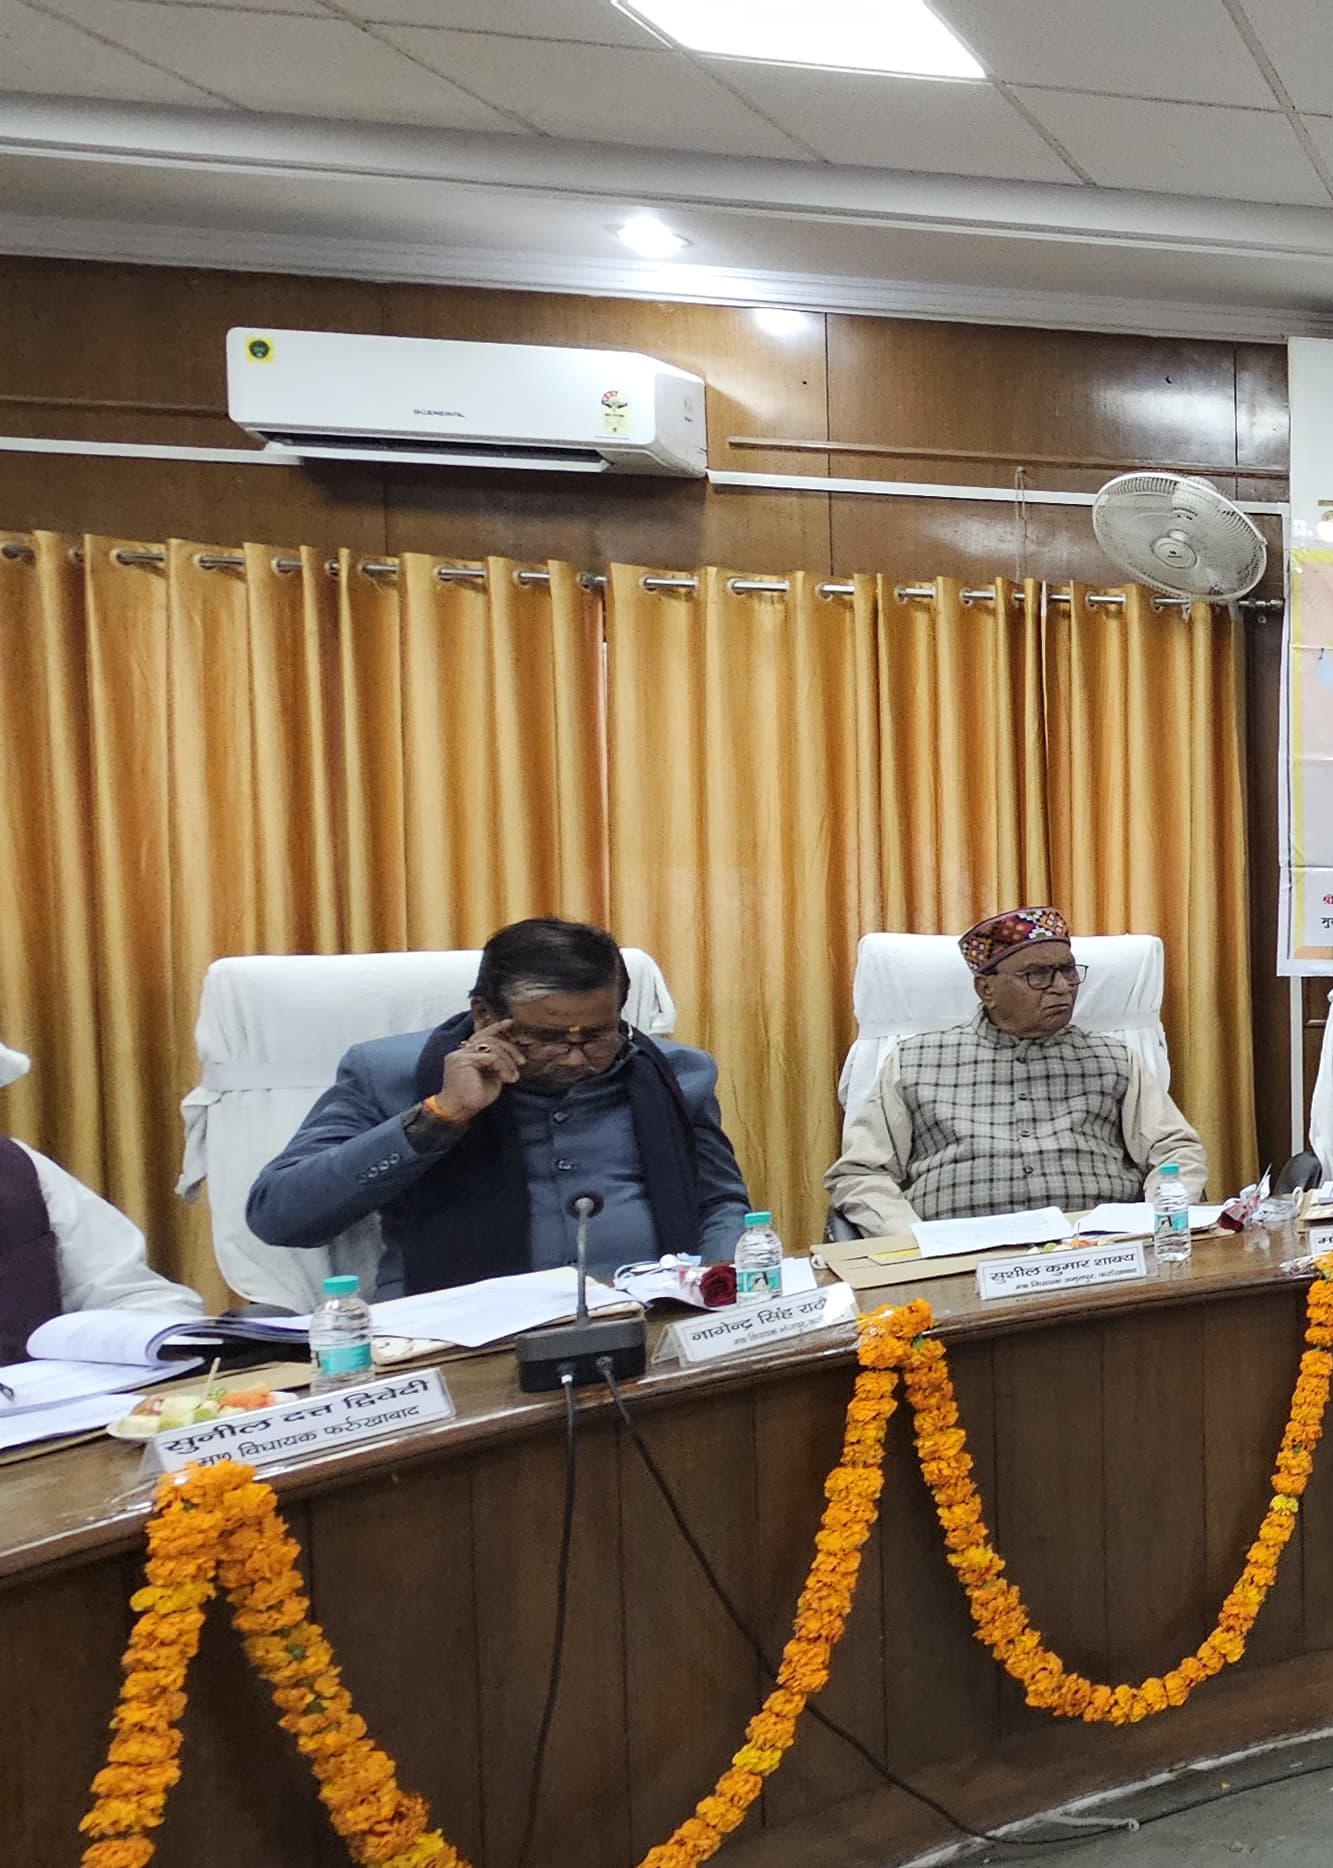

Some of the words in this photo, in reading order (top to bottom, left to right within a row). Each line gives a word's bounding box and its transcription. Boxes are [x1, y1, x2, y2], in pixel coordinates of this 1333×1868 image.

[991, 1265, 1040, 1284] सुशील
[1045, 1258, 1090, 1277] कुमार
[1094, 1253, 1135, 1266] शाक्य
[757, 1306, 793, 1327] सिंह
[163, 1416, 272, 1455] सुनील
[283, 1402, 333, 1424] दत्त
[344, 1379, 429, 1409] द्विवेदी
[239, 1430, 317, 1457] विधायक
